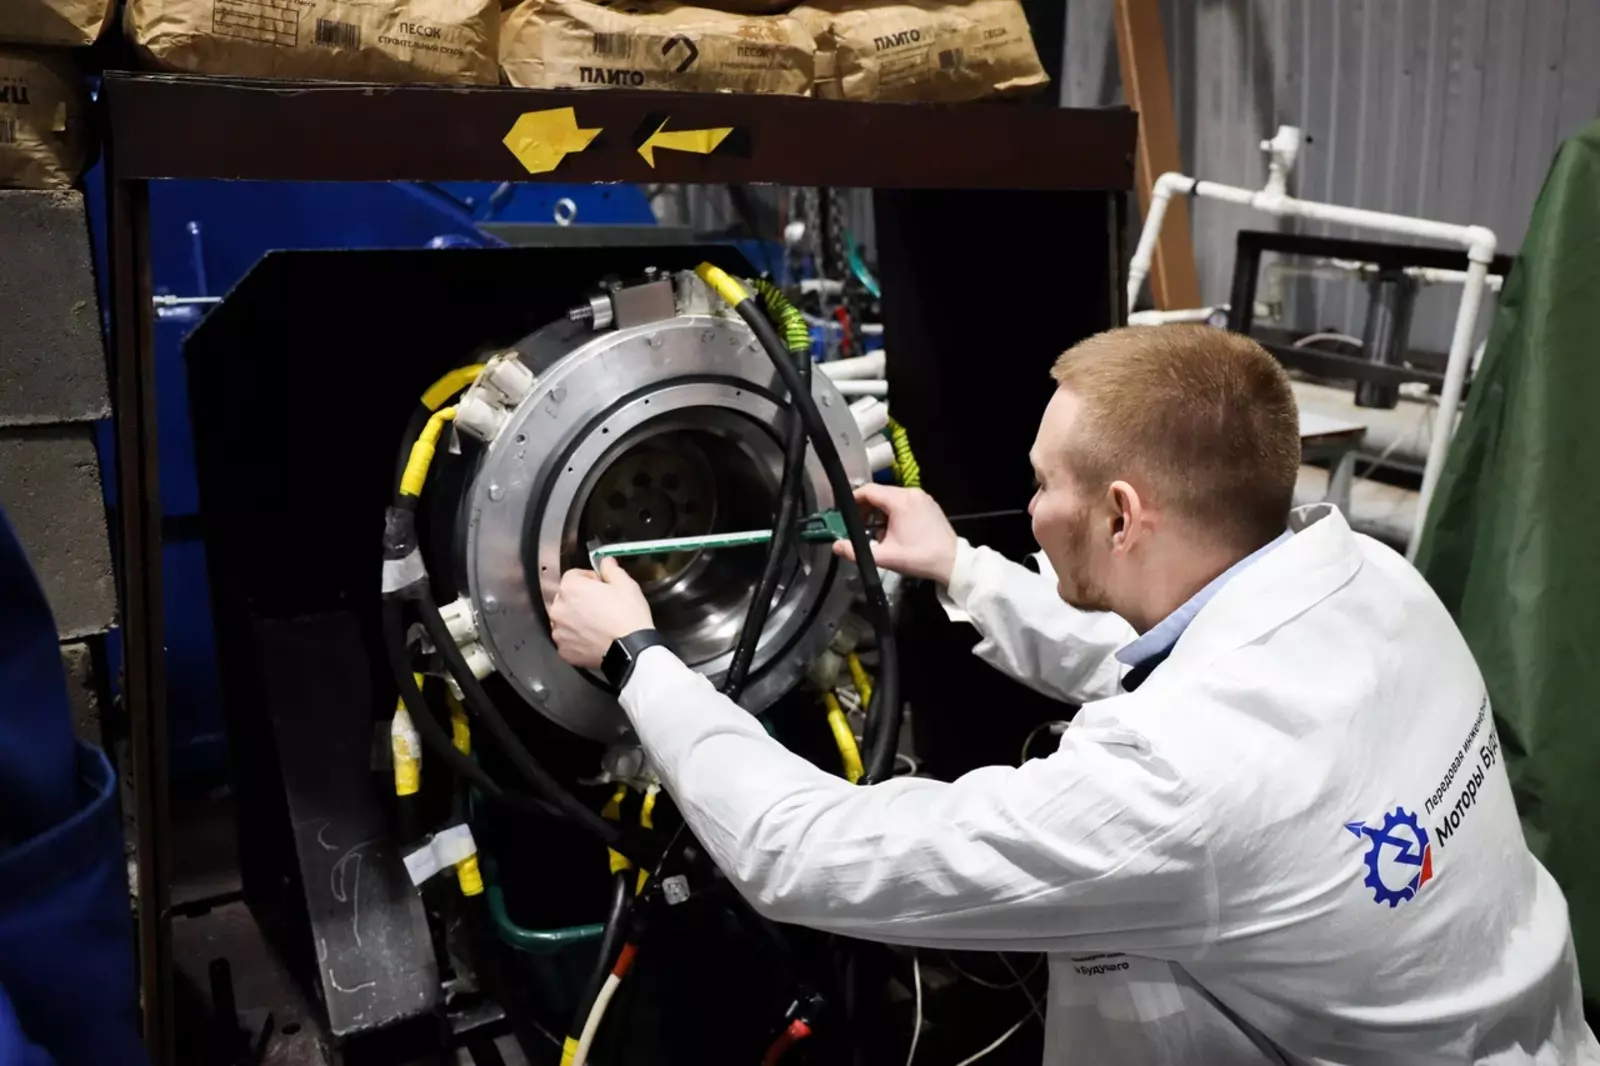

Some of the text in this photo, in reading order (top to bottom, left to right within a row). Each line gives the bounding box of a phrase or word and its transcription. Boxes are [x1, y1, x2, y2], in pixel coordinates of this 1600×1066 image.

[400, 22, 441, 39] ПЕСОК
[873, 29, 921, 51] ПЛИТО
[378, 35, 439, 53] СТРОИТЕЛЬНЫЙ
[580, 66, 645, 86] ПЛИТО
[1424, 750, 1465, 815] Передовая
[1435, 765, 1485, 848] Моторы
